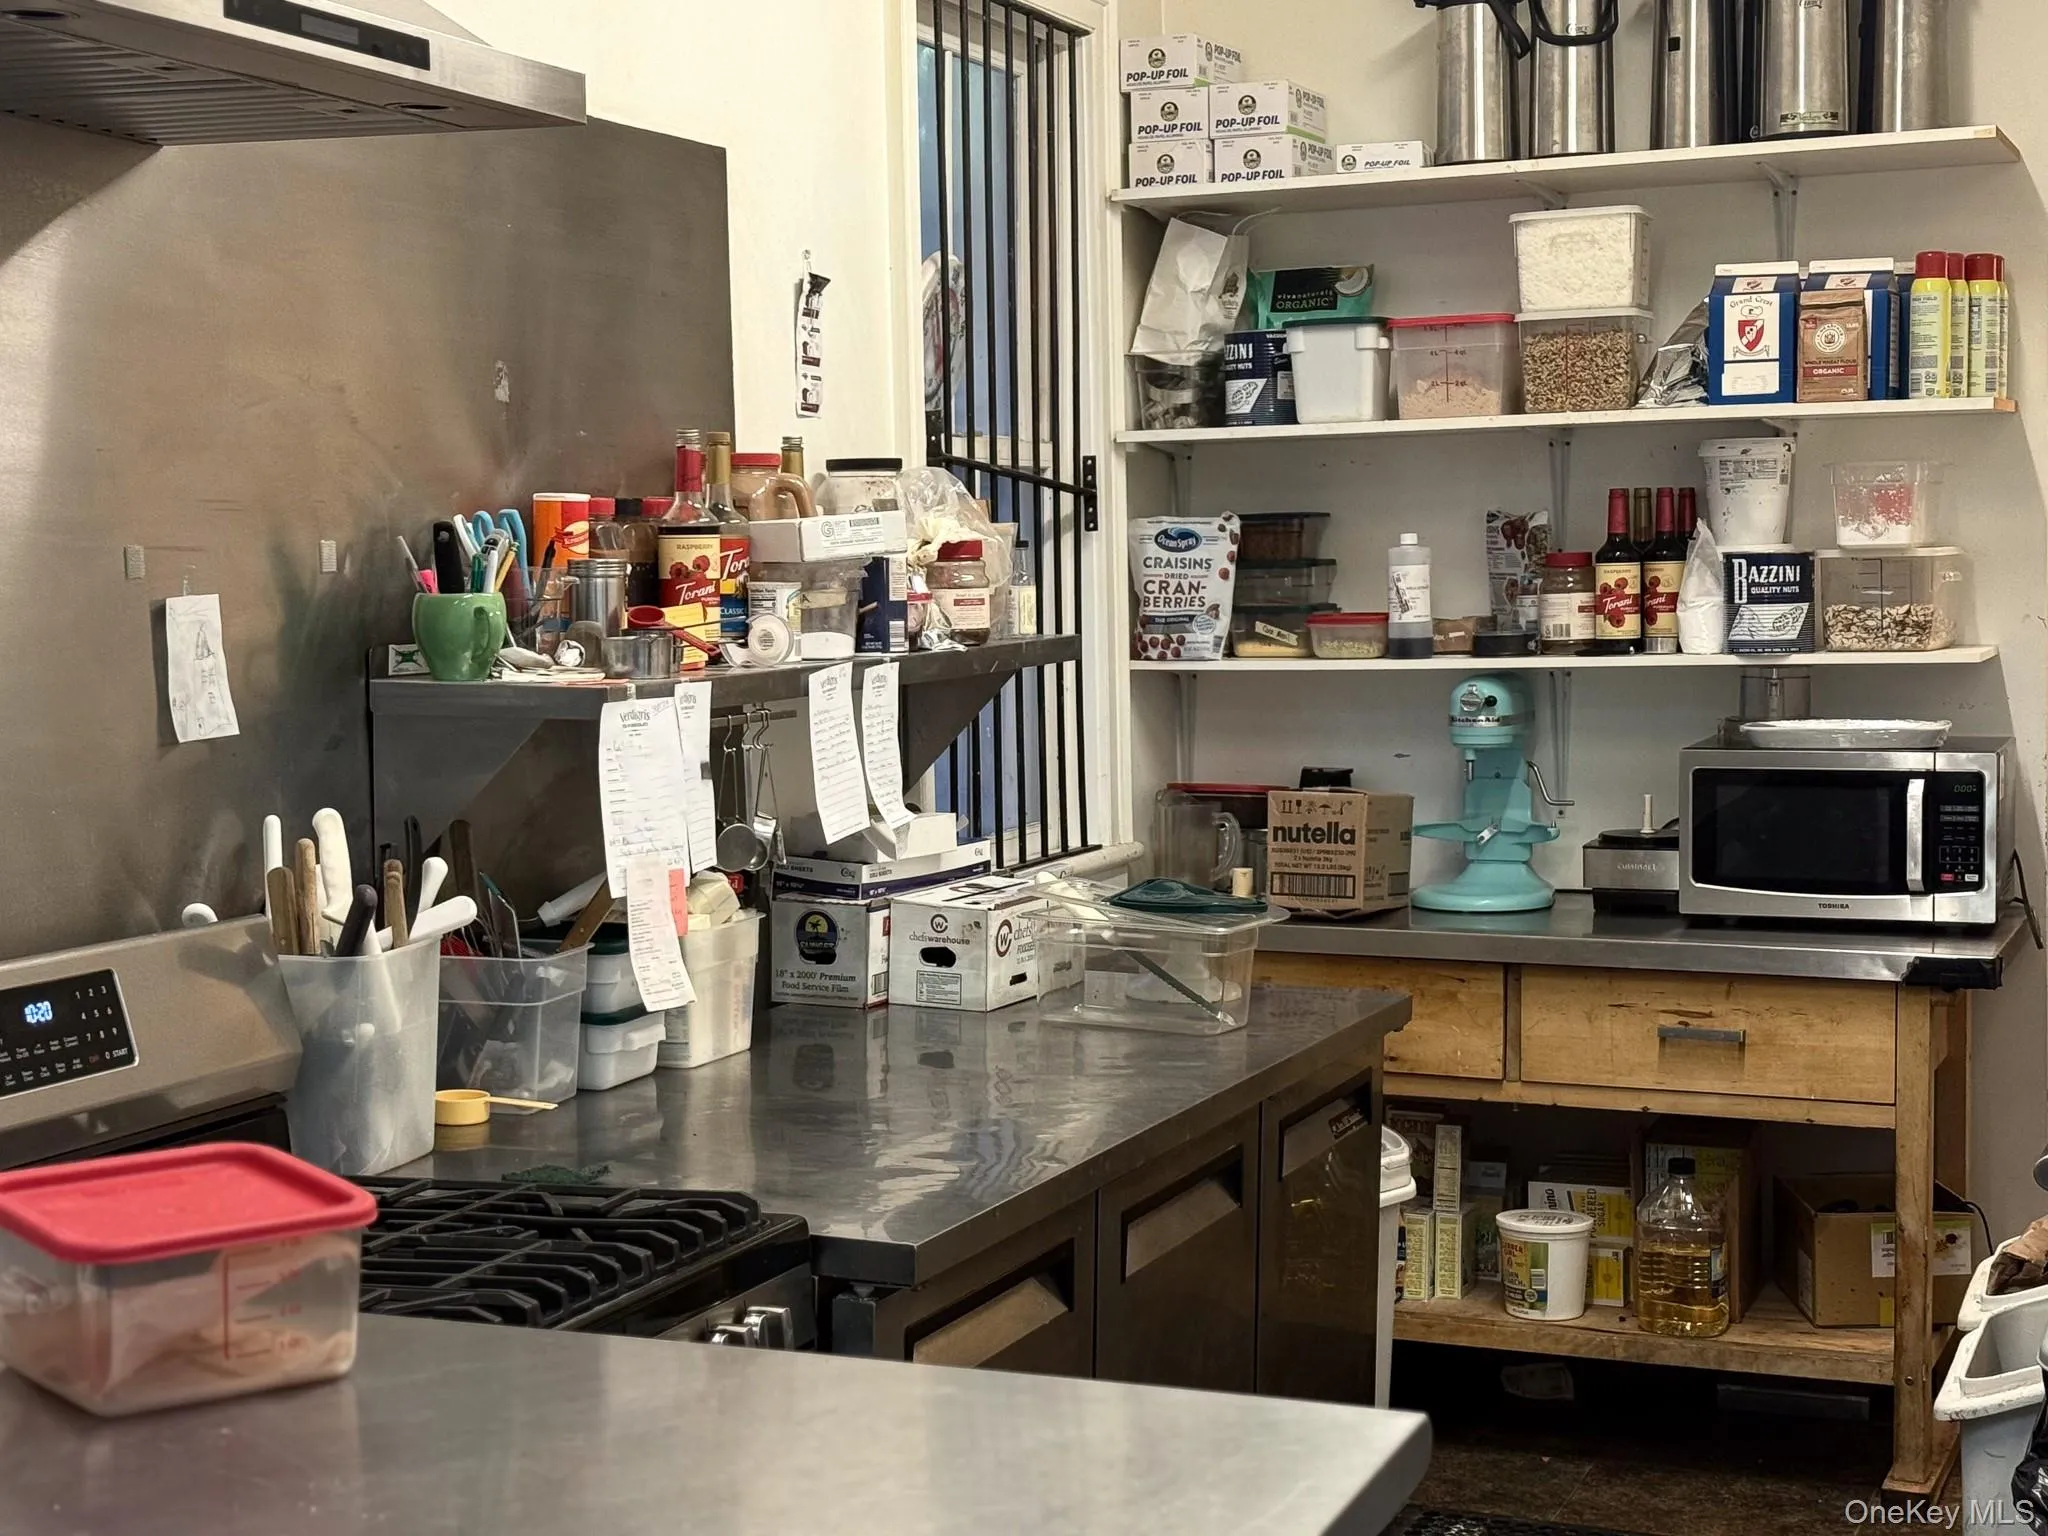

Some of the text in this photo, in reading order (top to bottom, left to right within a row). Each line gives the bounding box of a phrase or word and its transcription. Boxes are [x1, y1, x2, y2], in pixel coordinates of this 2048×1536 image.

[1126, 68, 1189, 82] POP-UP FOIL
[1138, 122, 1203, 135] POP-UP FOIL
[1216, 115, 1280, 129] POP-UP FOIL
[1136, 174, 1198, 188] POP-UP FOIL
[1221, 169, 1284, 182] POP-UP FOIL
[1276, 298, 1330, 310] ORGANIC
[1158, 534, 1196, 549] Ocean Spray
[720, 548, 750, 581] Tora
[1143, 556, 1213, 570] CRAISINS
[1143, 580, 1207, 595] CRAN-
[1732, 558, 1800, 604] BAZZINI
[676, 580, 716, 606] Torani
[1143, 596, 1206, 608] BERRIES
[1602, 595, 1633, 614] Torani
[1272, 821, 1356, 845] nutella
[819, 972, 856, 981] Premium
[75, 986, 107, 999] 1 2 3
[782, 980, 849, 992] Food Service Film
[94, 1009, 99, 1018] 5
[107, 1006, 112, 1015] 6
[86, 1027, 118, 1042] 7 8 9
[112, 1048, 128, 1058] START
[1586, 1188, 1597, 1238] PODERED
